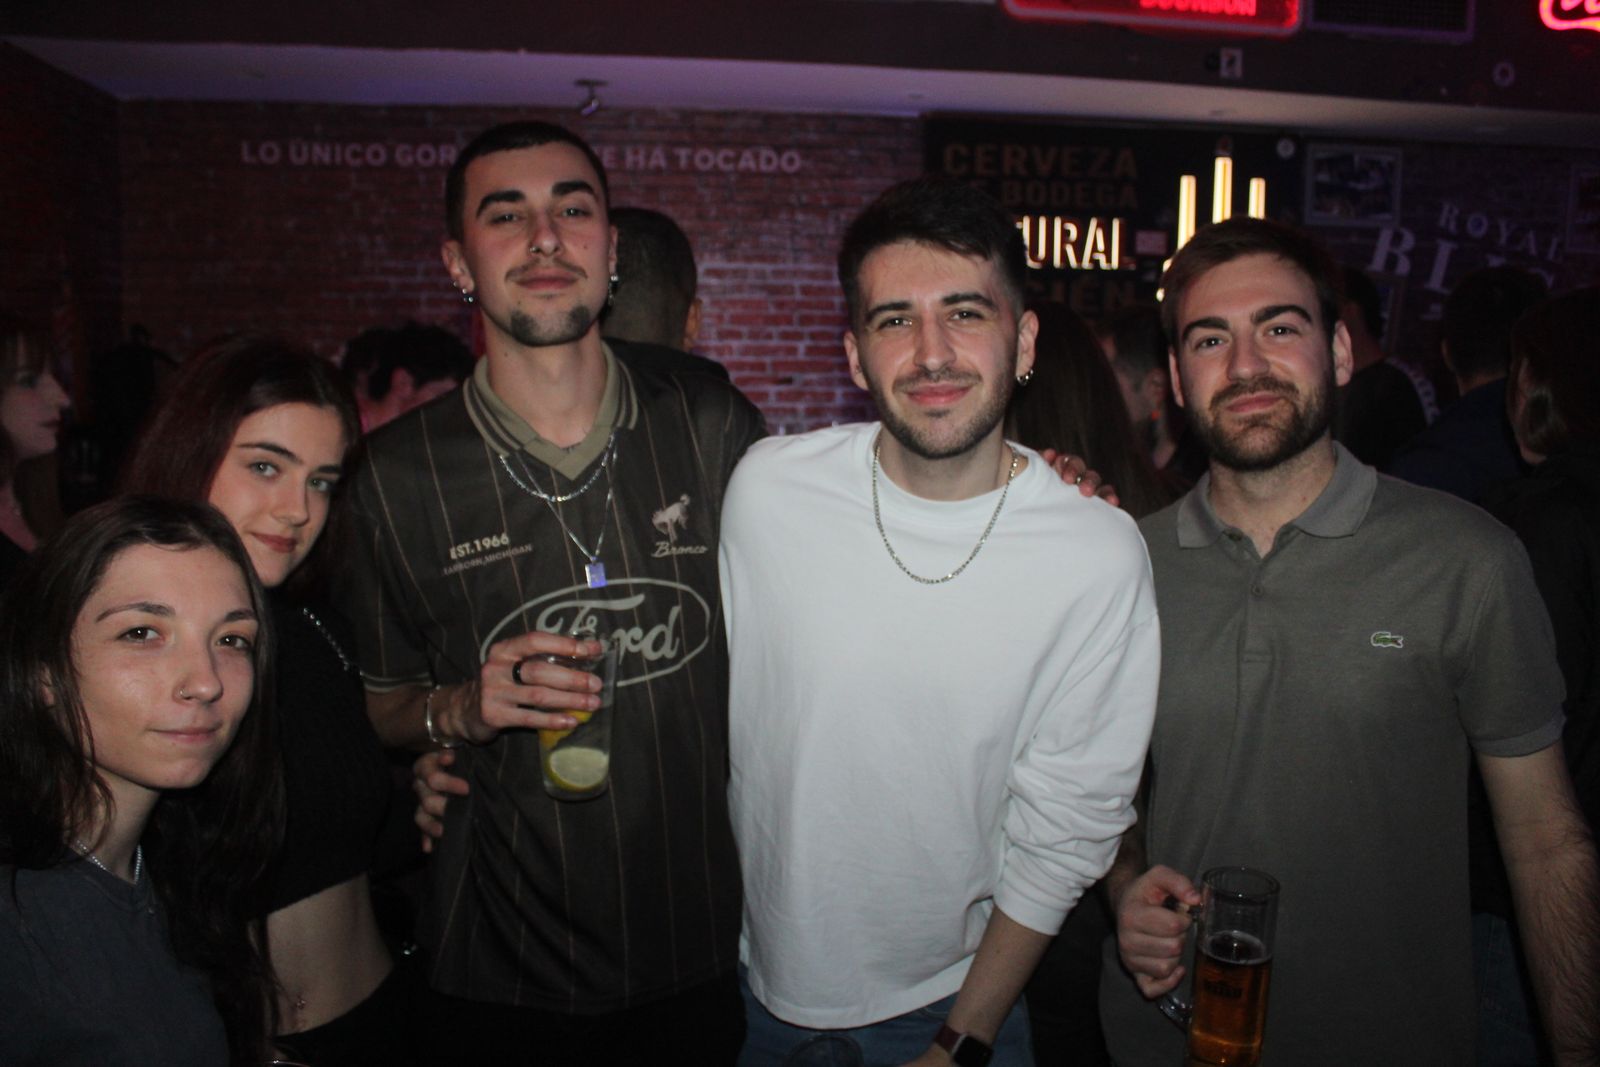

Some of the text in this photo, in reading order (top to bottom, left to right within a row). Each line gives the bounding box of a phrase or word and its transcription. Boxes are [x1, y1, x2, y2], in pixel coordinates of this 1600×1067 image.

[241, 140, 282, 166] LO
[394, 143, 459, 167] GOR
[672, 147, 802, 173] TOCADO
[942, 142, 1138, 178] CERVEZA
[1001, 180, 1138, 210] BODEGA
[1016, 215, 1137, 271] URAL
[448, 532, 511, 560] EST.1966
[651, 541, 708, 558] Bronco
[536, 593, 681, 665] Frd
